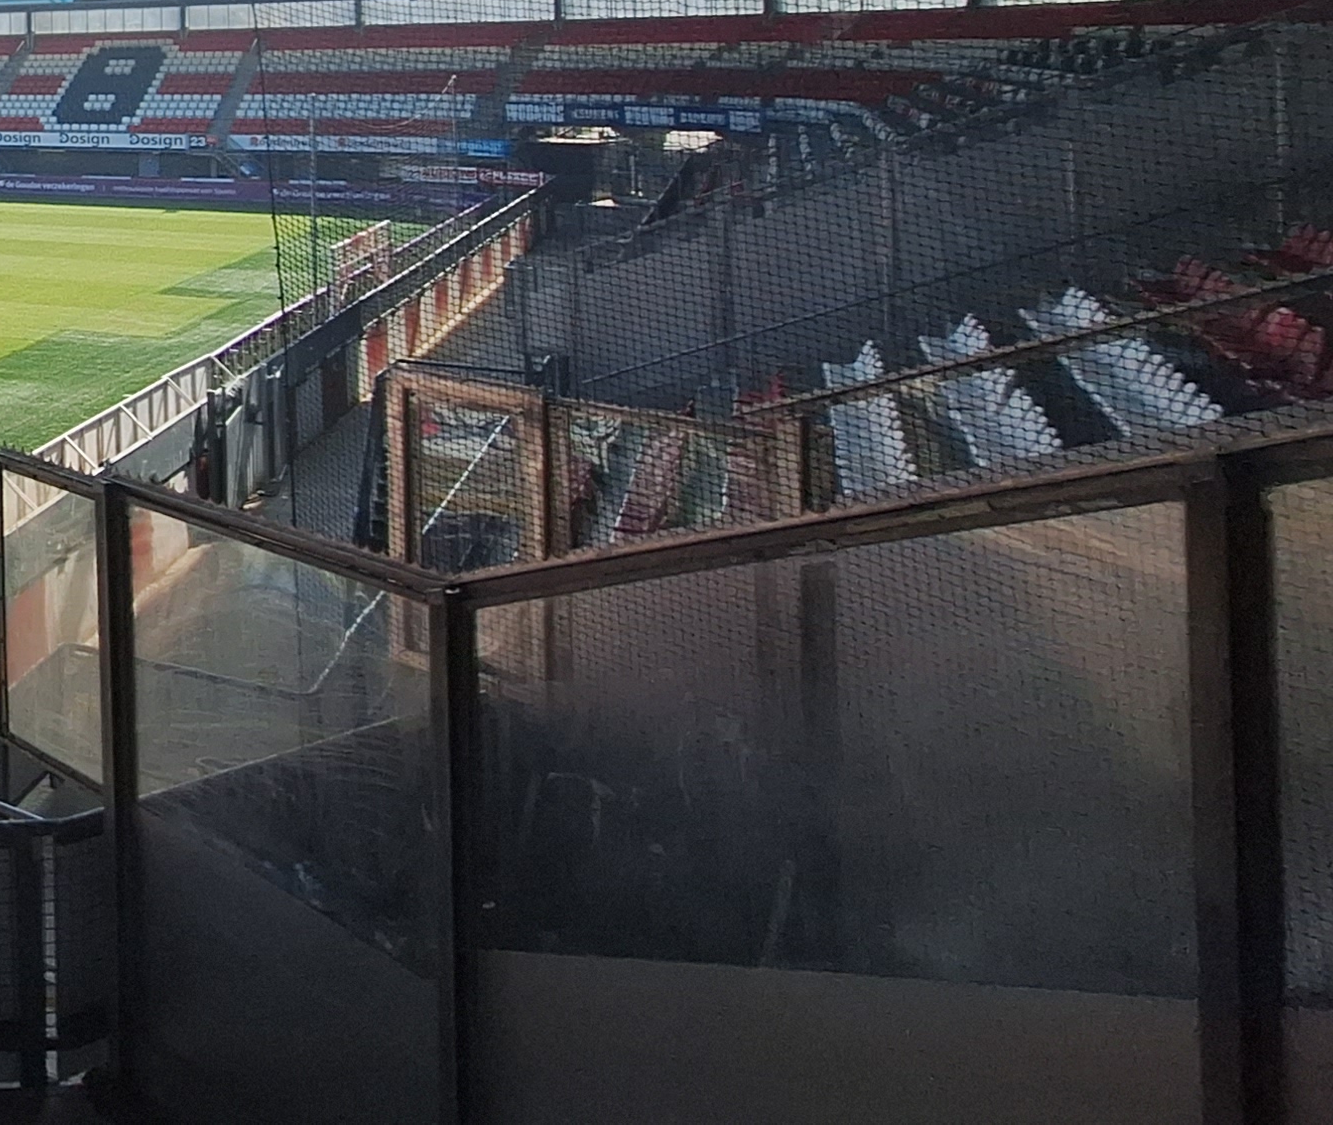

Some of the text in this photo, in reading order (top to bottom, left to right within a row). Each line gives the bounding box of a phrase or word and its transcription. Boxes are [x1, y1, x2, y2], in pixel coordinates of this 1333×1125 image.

[59, 132, 110, 148] Dosign
[129, 134, 183, 148] Dosign
[190, 136, 207, 146] 23
